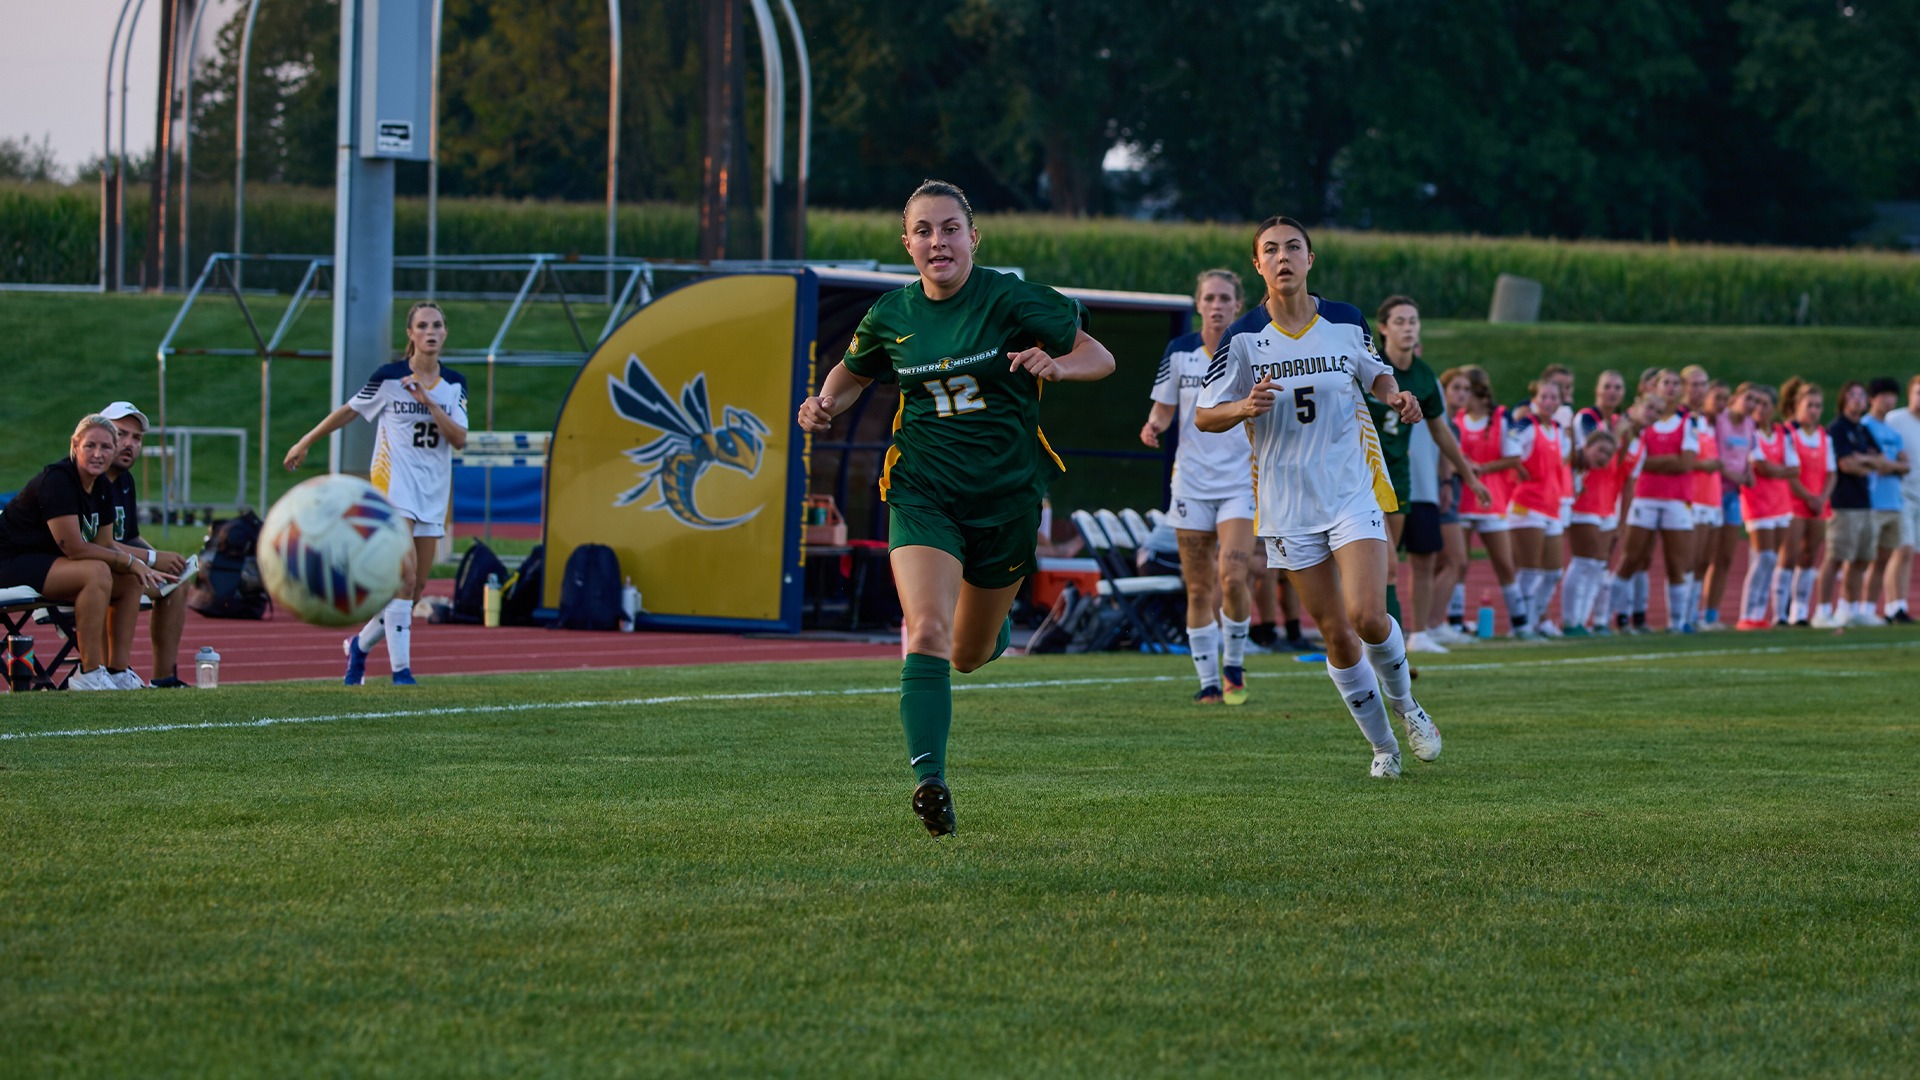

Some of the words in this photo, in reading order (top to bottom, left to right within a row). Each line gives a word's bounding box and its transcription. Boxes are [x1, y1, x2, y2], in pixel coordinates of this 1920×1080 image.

[953, 349, 998, 367] MICHIGAN
[1251, 355, 1349, 384] CEDARVILLE
[922, 374, 987, 418] 12
[1294, 386, 1316, 424] 5
[413, 421, 440, 448] 25
[1383, 410, 1399, 435] 2
